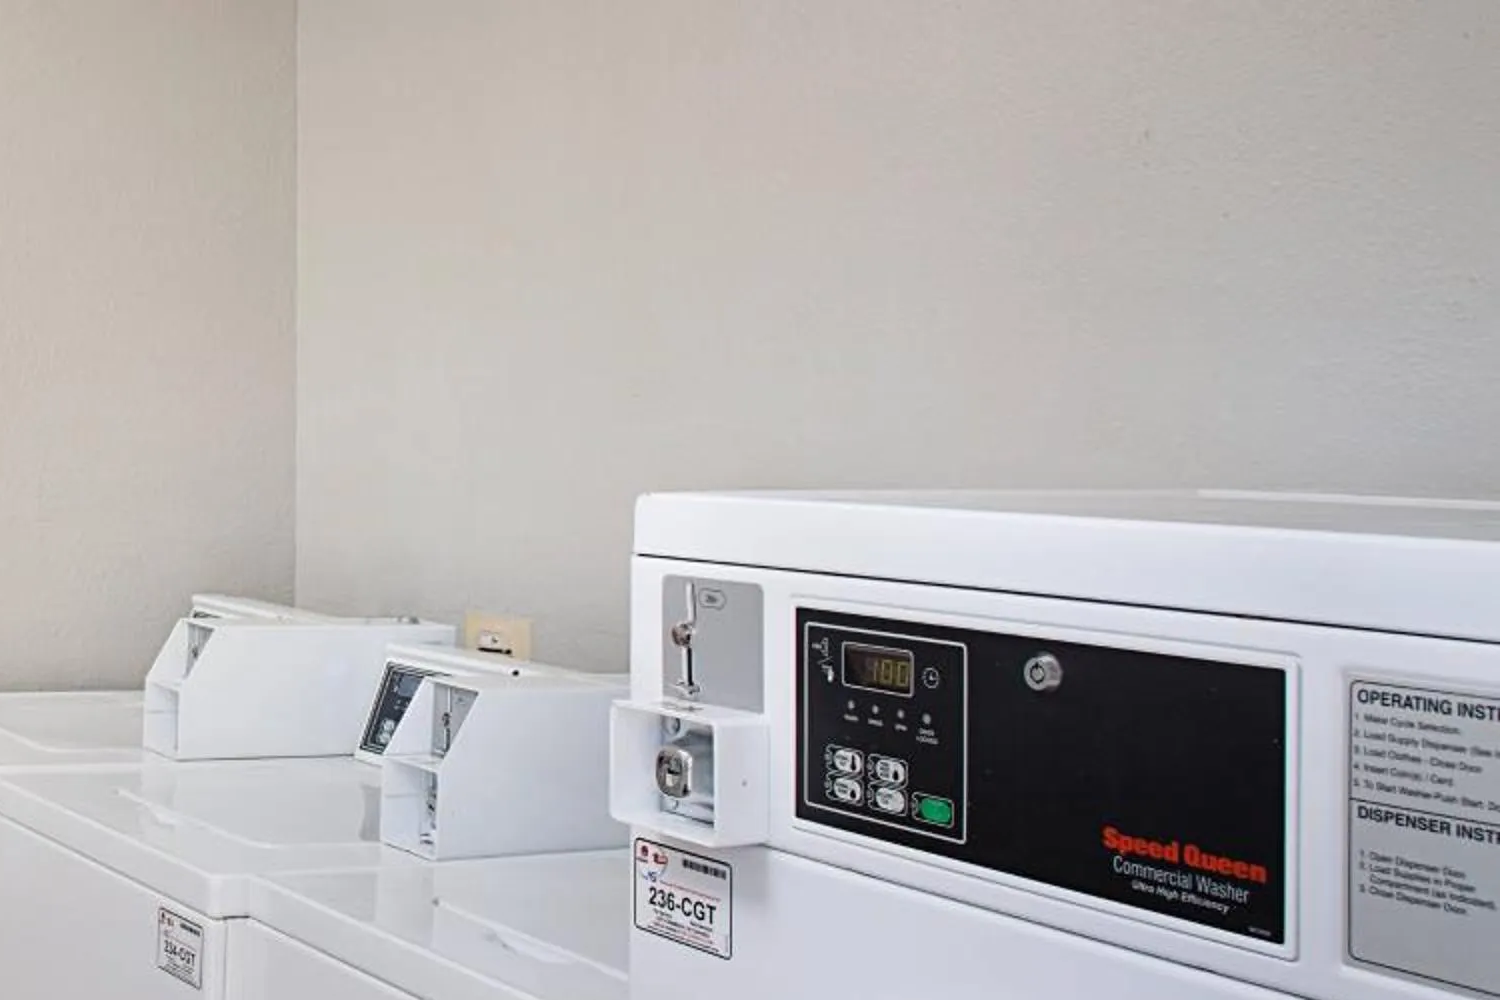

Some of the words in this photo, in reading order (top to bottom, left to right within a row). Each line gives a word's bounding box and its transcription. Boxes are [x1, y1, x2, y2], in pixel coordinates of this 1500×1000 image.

[1357, 689, 1452, 716] OPERATING
[1357, 805, 1451, 837] DISPENSER
[1103, 825, 1180, 864] Speed
[1184, 843, 1267, 884] Queen
[1112, 855, 1193, 891] Commercial
[1195, 873, 1250, 903] Washer
[649, 885, 717, 924] 236-CGT
